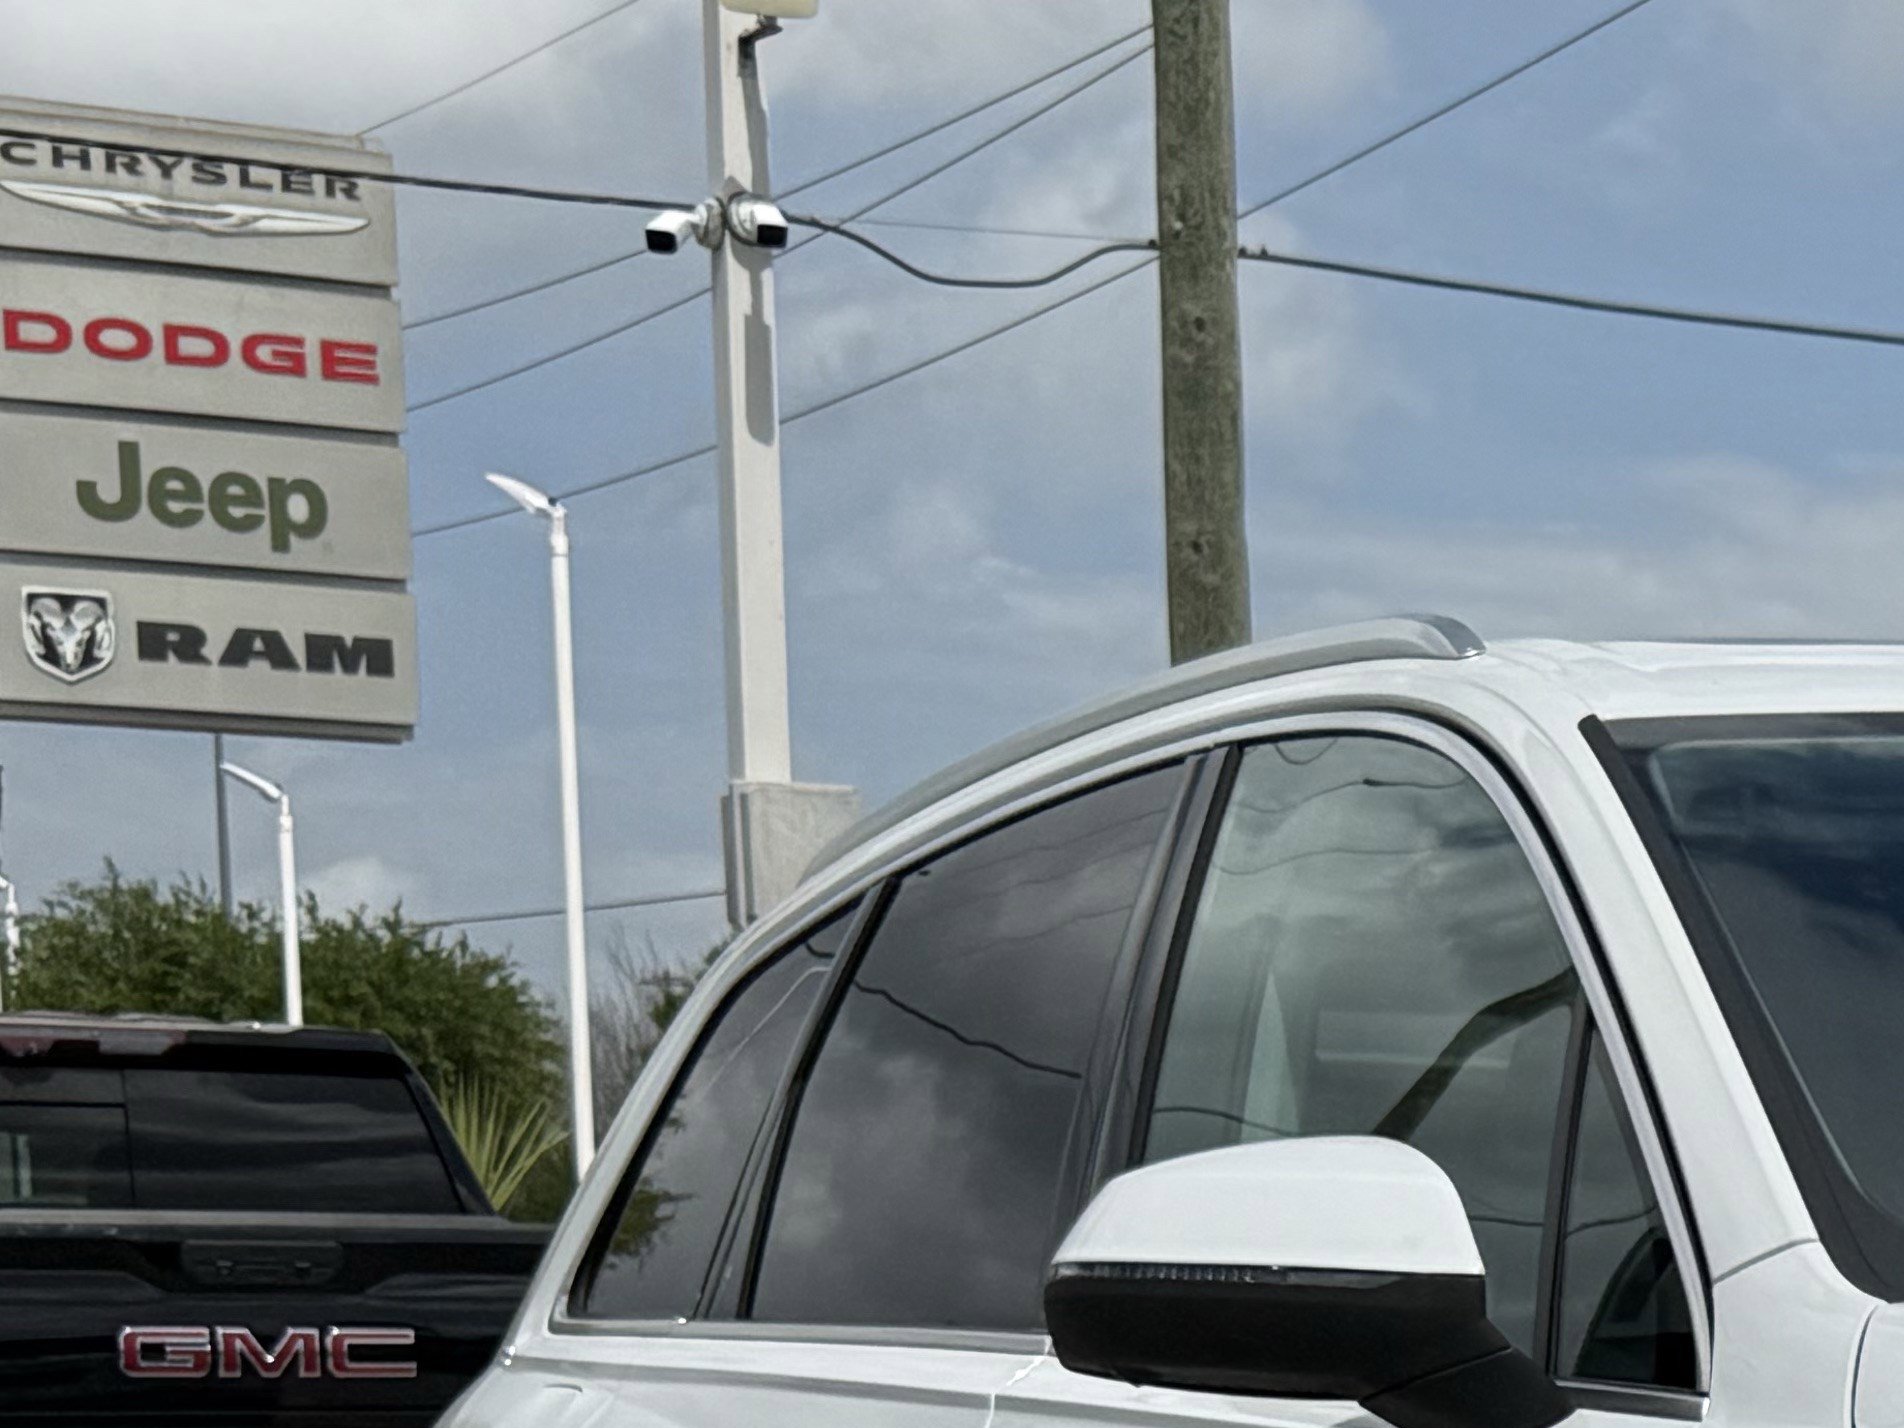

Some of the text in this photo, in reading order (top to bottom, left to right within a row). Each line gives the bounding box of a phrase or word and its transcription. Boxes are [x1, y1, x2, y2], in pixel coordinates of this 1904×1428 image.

[0, 141, 362, 201] CHRYSLER
[3, 309, 381, 385] DODGE
[76, 440, 329, 554] Jeep
[136, 620, 396, 679] RAM
[118, 1326, 418, 1379] GMC
